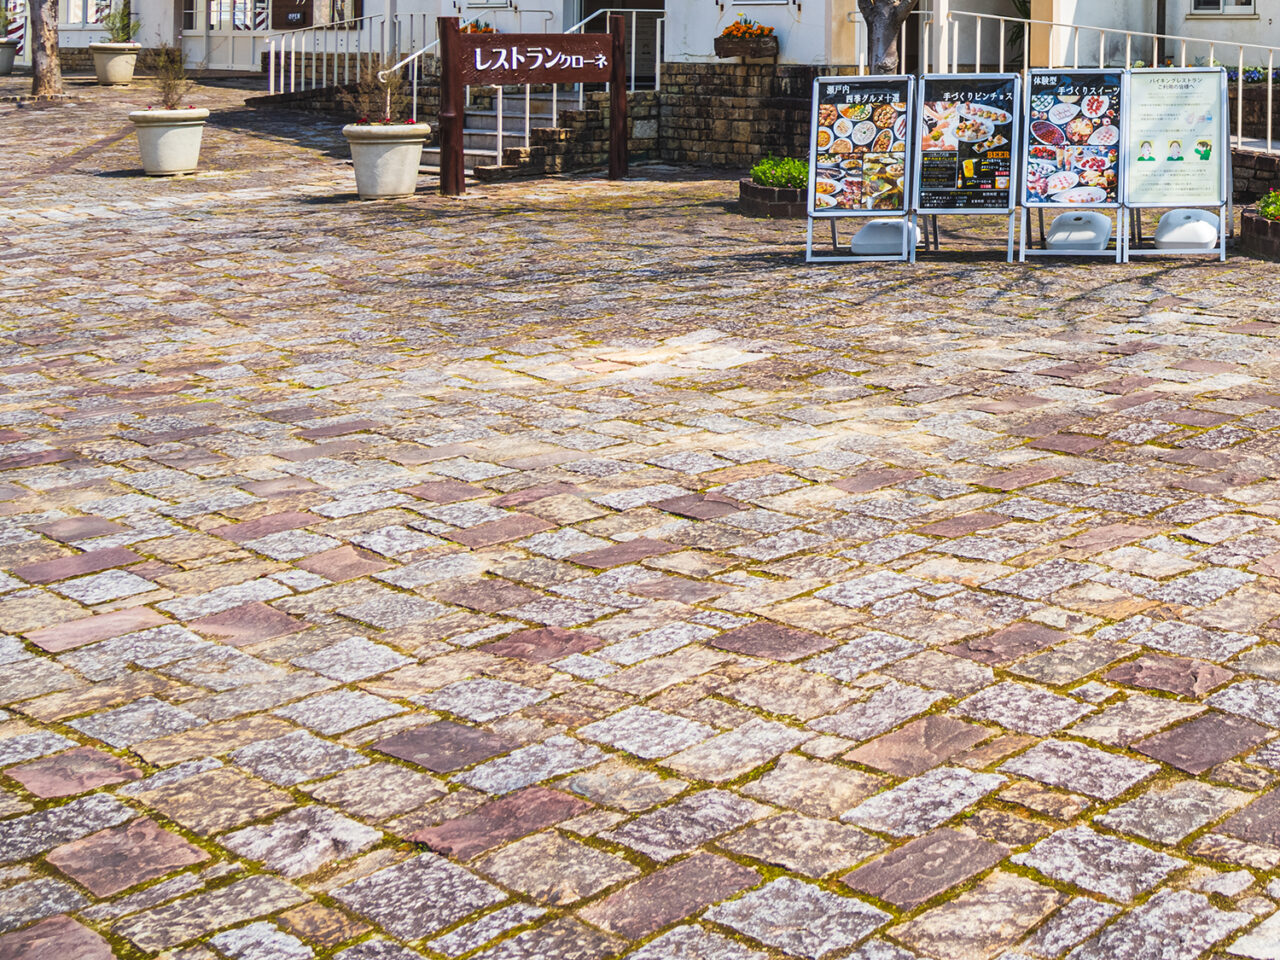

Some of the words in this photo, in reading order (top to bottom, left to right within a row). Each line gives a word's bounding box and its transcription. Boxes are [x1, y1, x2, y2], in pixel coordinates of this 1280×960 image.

[1033, 76, 1057, 86] 体験型
[826, 84, 850, 95] 瀬戸内
[1057, 86, 1120, 95] 手づくりスイーツ
[846, 93, 900, 103] 四季グルメ十選
